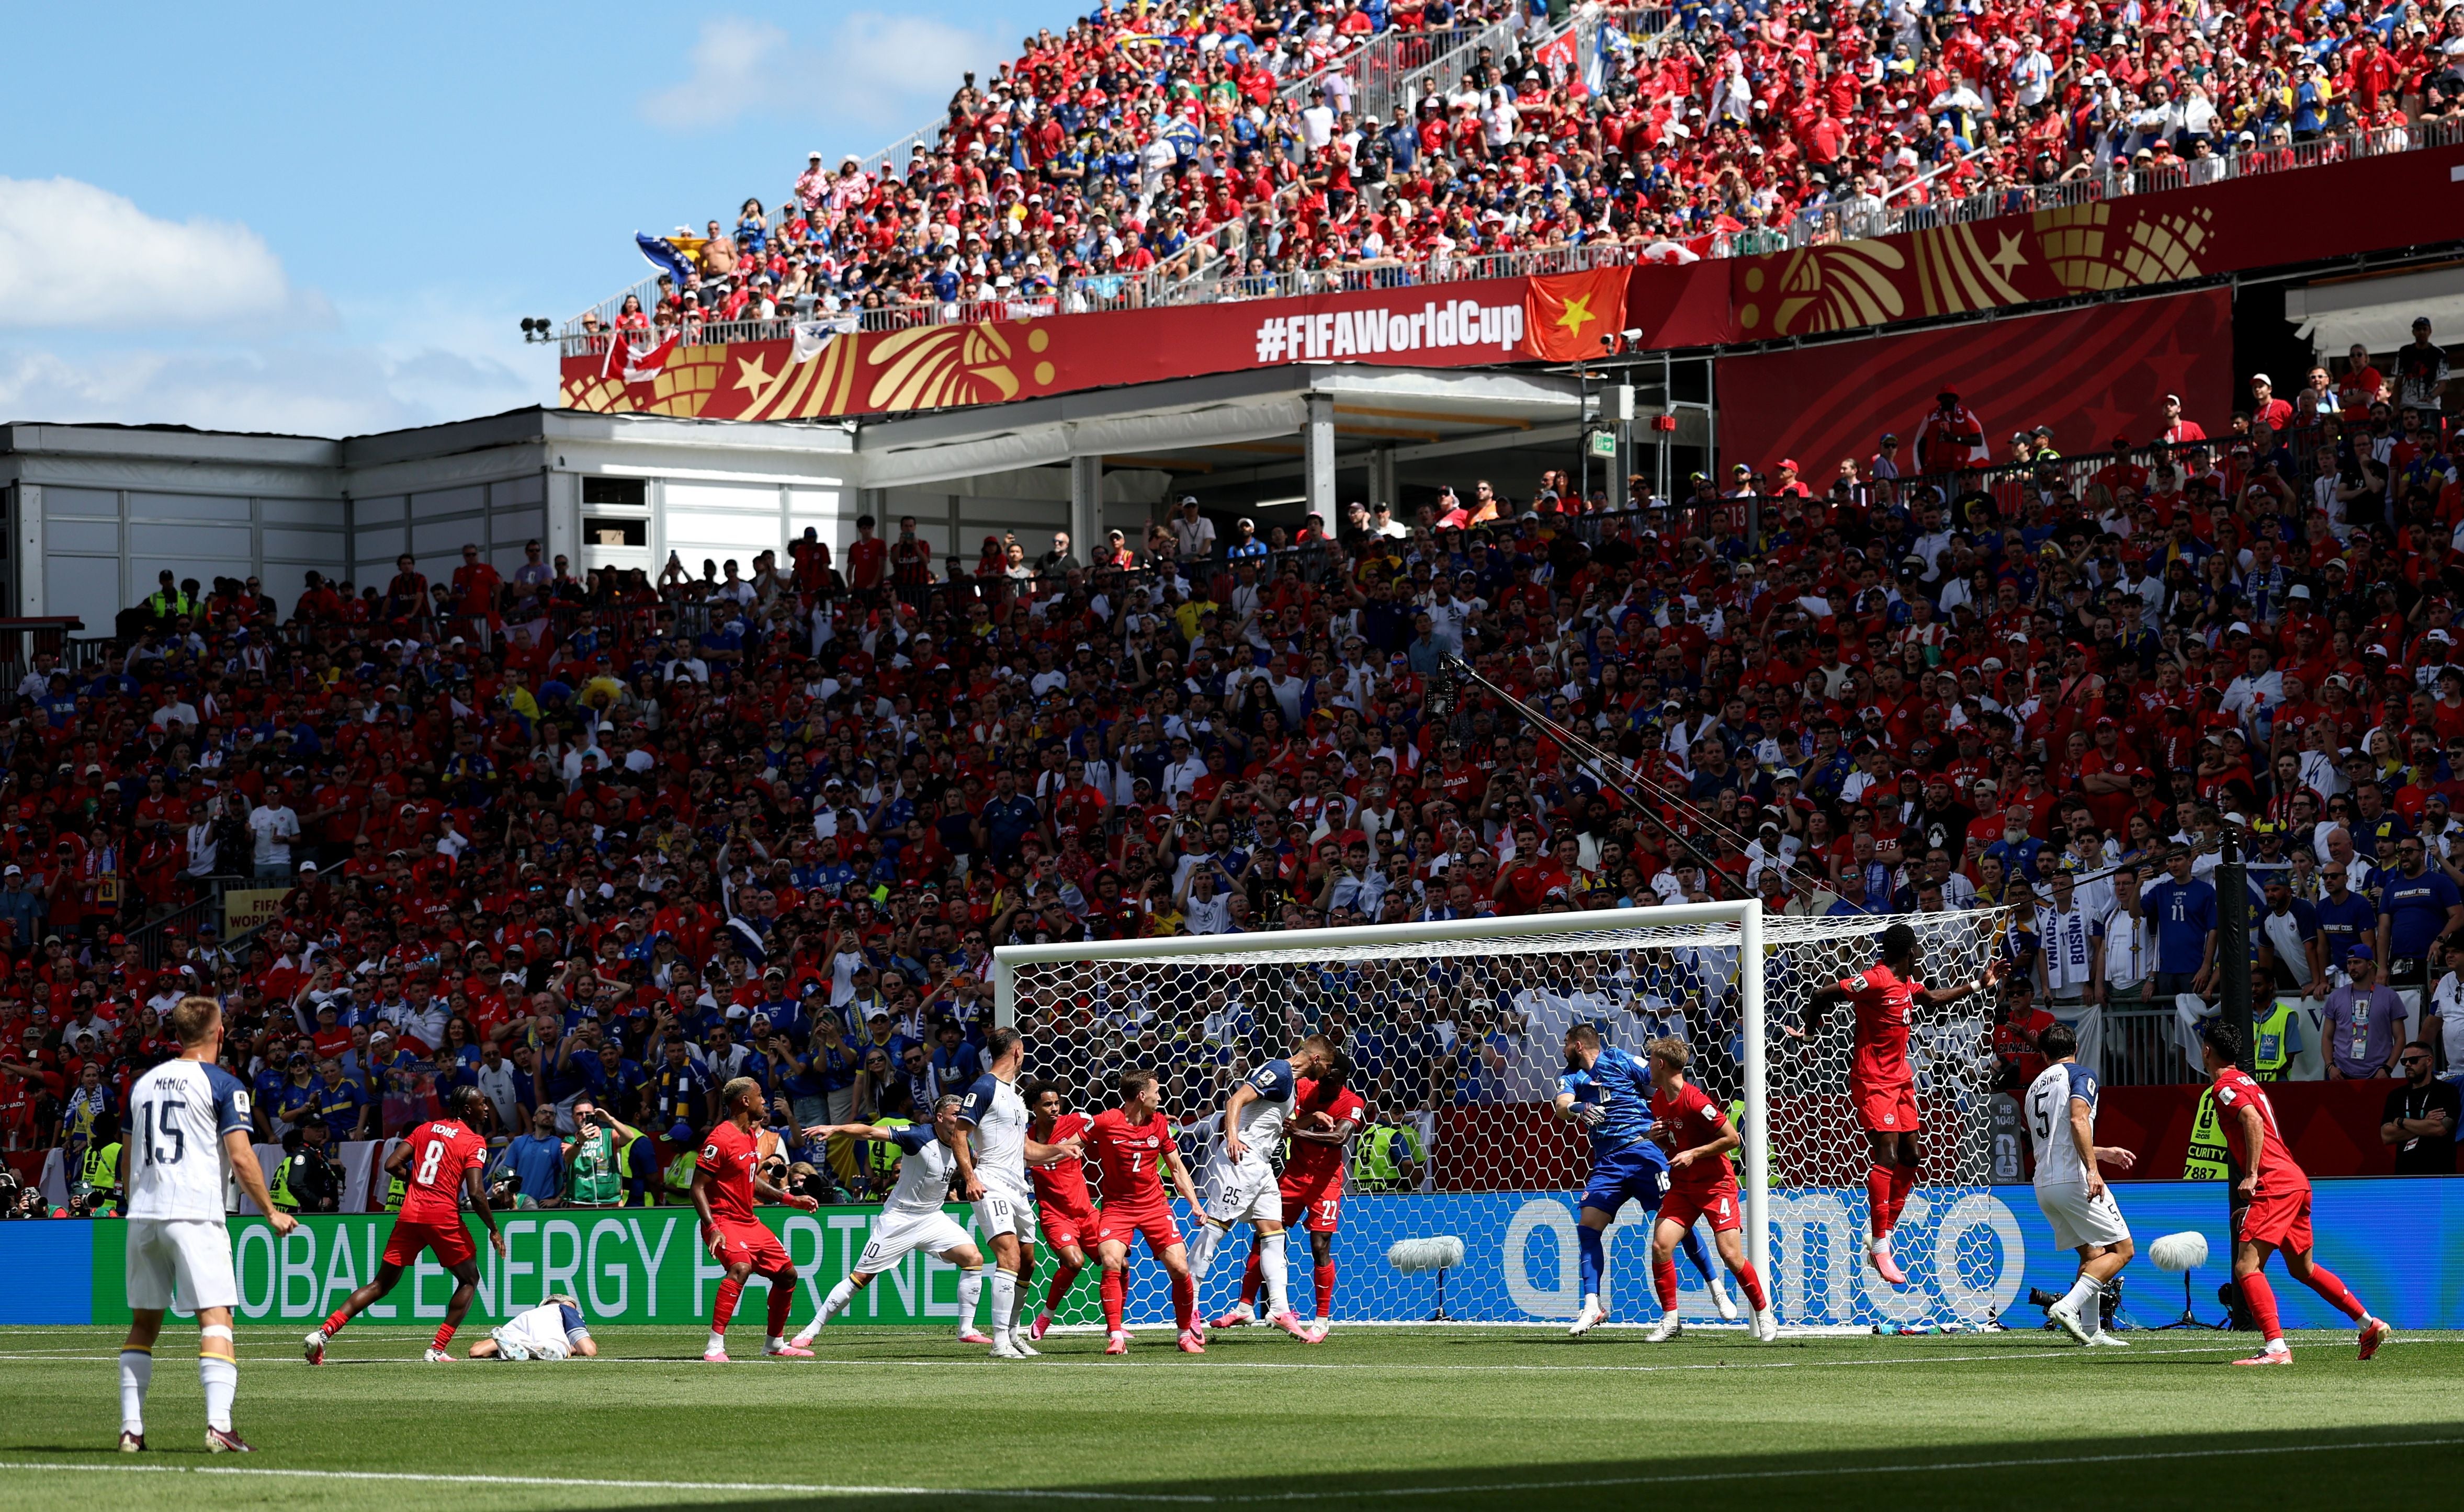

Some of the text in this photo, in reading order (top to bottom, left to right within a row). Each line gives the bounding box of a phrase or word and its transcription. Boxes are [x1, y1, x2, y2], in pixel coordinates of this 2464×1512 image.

[1256, 300, 1524, 362] #FIFAWorldCup
[2168, 736, 2177, 768] CANADA
[1875, 838, 1896, 851] ETS
[1203, 911, 1214, 922] 20
[2171, 905, 2185, 922] 11
[2071, 914, 2085, 965] BOSNA
[1998, 1041, 2040, 1055] CANAD
[1999, 1103, 2013, 1115] HB
[2035, 1092, 2050, 1141] 5
[431, 1123, 459, 1139] KONÉ
[1995, 1116, 2016, 1127] 1048
[143, 1100, 189, 1166] 15
[582, 1141, 602, 1151] OTO
[418, 1140, 445, 1185] 8
[1133, 1152, 1141, 1173] 2
[1655, 1171, 1671, 1192] 16
[1223, 1186, 1241, 1206] 25
[993, 1200, 1008, 1217] 18
[1323, 1200, 1338, 1221] 22
[1720, 1198, 1731, 1217] 4
[2108, 1203, 2120, 1222] 5
[864, 1241, 880, 1259] 10
[414, 1217, 677, 1317] ENERGY
[694, 1214, 996, 1317] PRTNE
